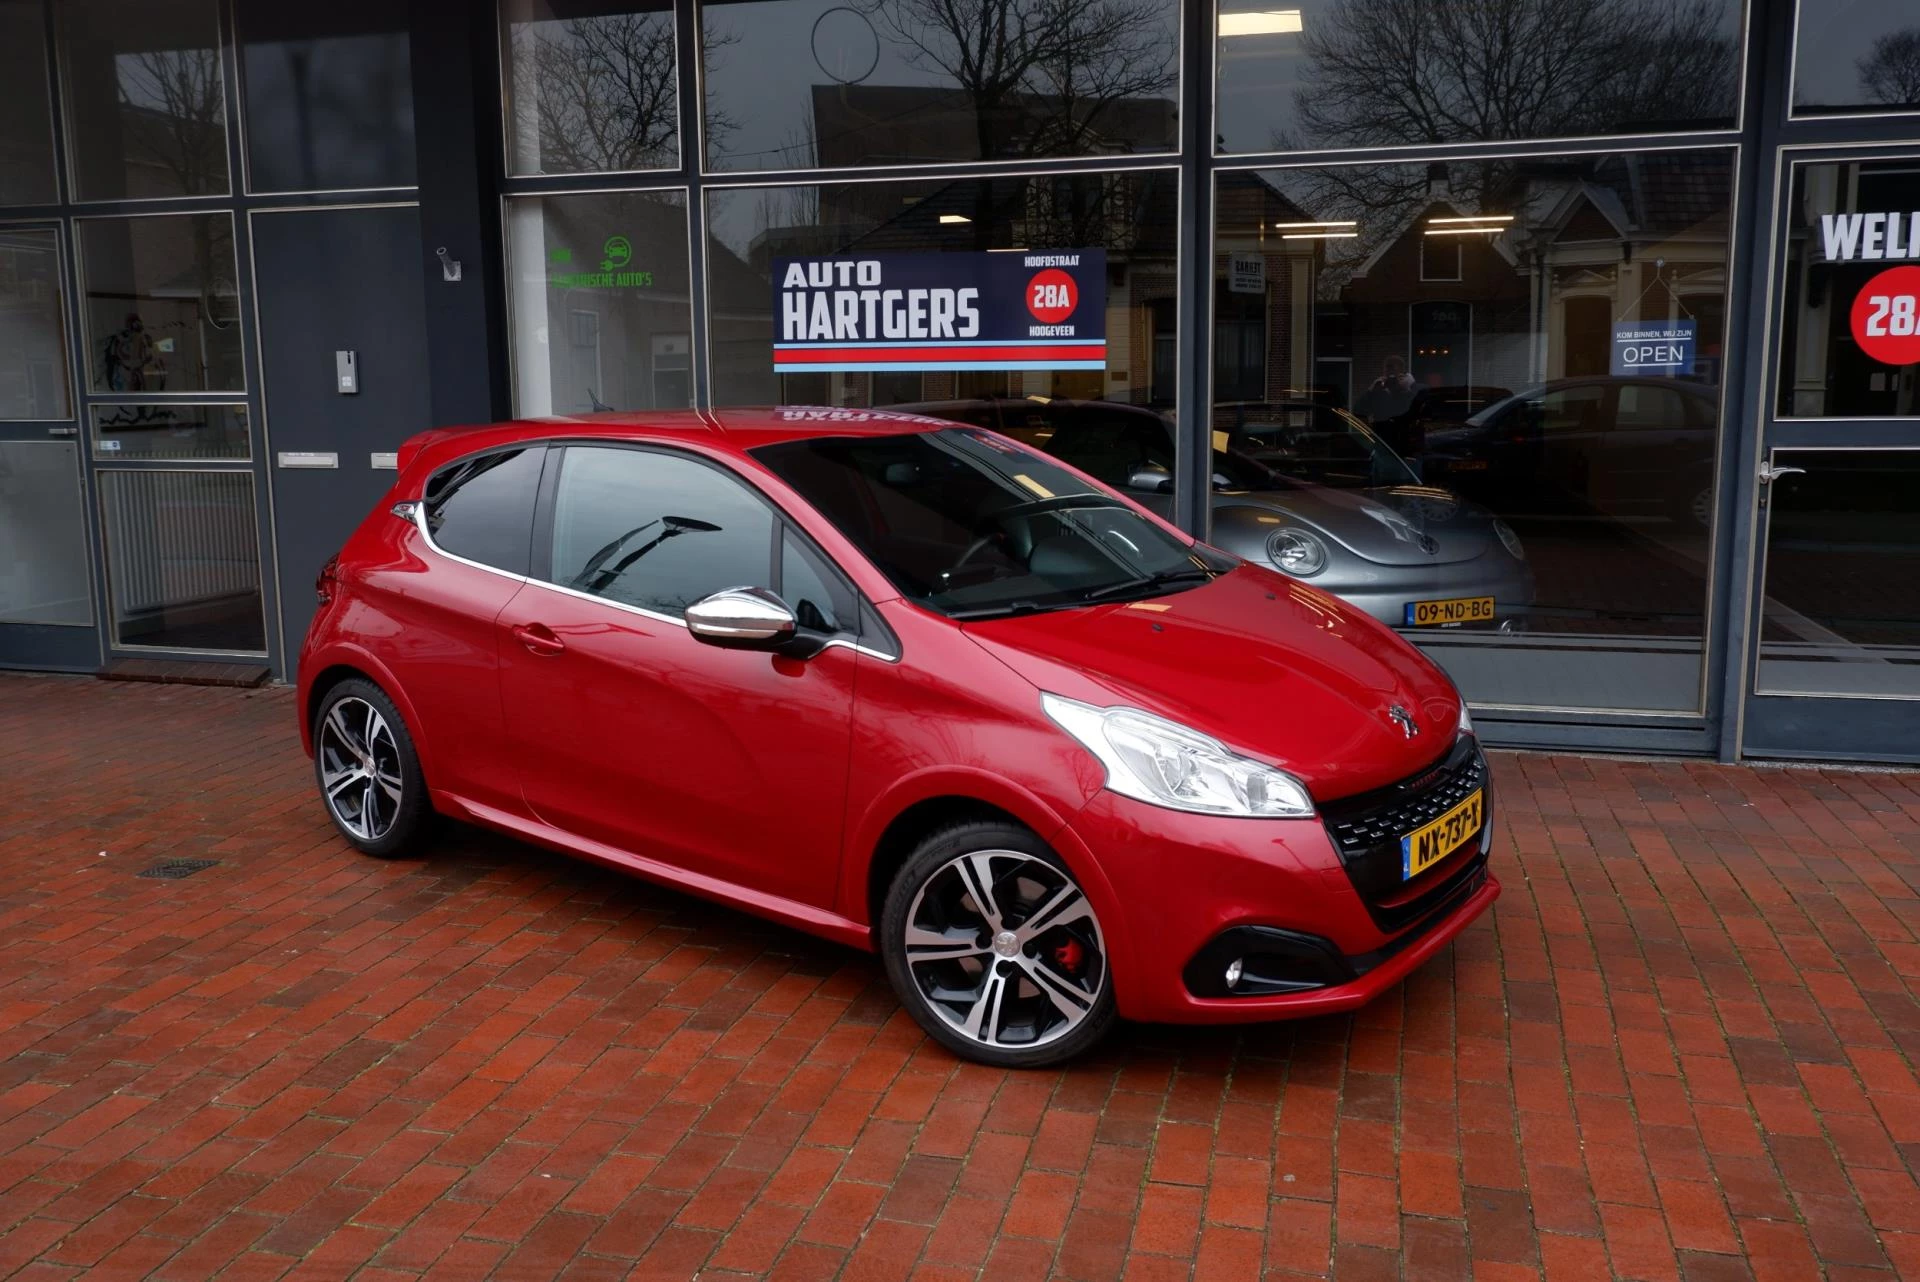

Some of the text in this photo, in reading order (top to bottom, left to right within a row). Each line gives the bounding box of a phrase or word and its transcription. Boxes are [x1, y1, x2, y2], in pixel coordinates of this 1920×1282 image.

[1024, 255, 1080, 268] HOOFDSTRAAT
[616, 271, 653, 288] AUTO'S
[783, 260, 881, 288] AUTO
[1033, 285, 1070, 309] 28A
[783, 288, 979, 341] HARTGERS
[1866, 295, 1920, 337] 28
[1029, 325, 1075, 338] HOOGEVEEN
[1616, 329, 1692, 339] KOM BINNEN, WIJ ZIJN
[1623, 345, 1683, 363] OPEN
[1417, 600, 1491, 622] 09-ND-BG
[1418, 799, 1479, 867] NX-737-X
